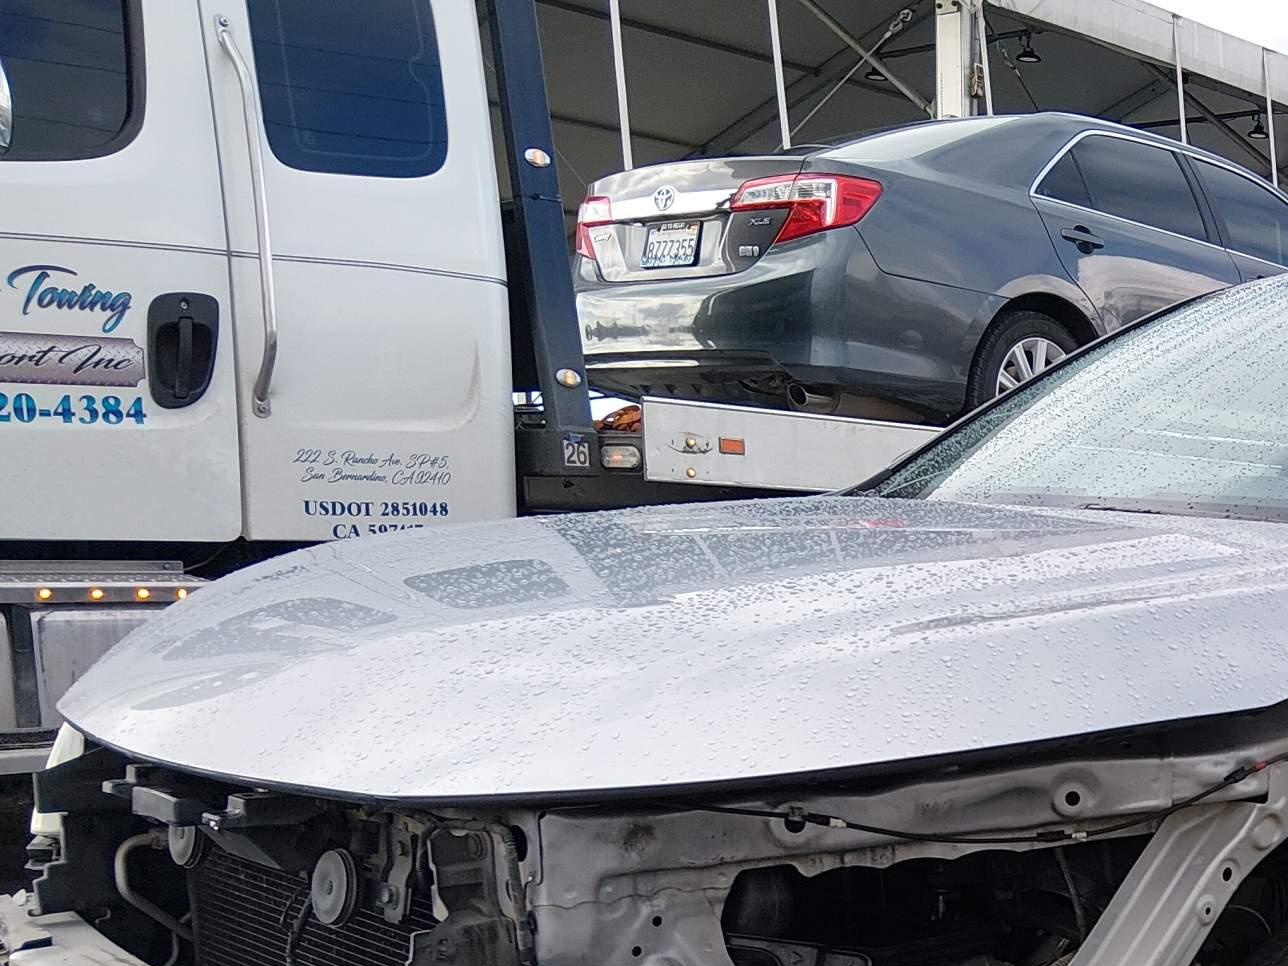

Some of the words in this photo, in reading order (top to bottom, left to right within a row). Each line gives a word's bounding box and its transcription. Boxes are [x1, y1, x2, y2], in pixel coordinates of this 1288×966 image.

[7, 264, 132, 333] Towing
[58, 344, 134, 374] Inc
[293, 448, 322, 463] 222
[323, 450, 338, 466] S.
[341, 451, 379, 466] Rancho
[565, 442, 588, 465] 26
[301, 467, 325, 483] San
[328, 468, 388, 484] Bernardino,
[391, 471, 416, 486] CA
[415, 471, 452, 486] 92410
[303, 500, 374, 517] USDOT
[380, 501, 449, 517] 2851048
[333, 524, 361, 539] CA
